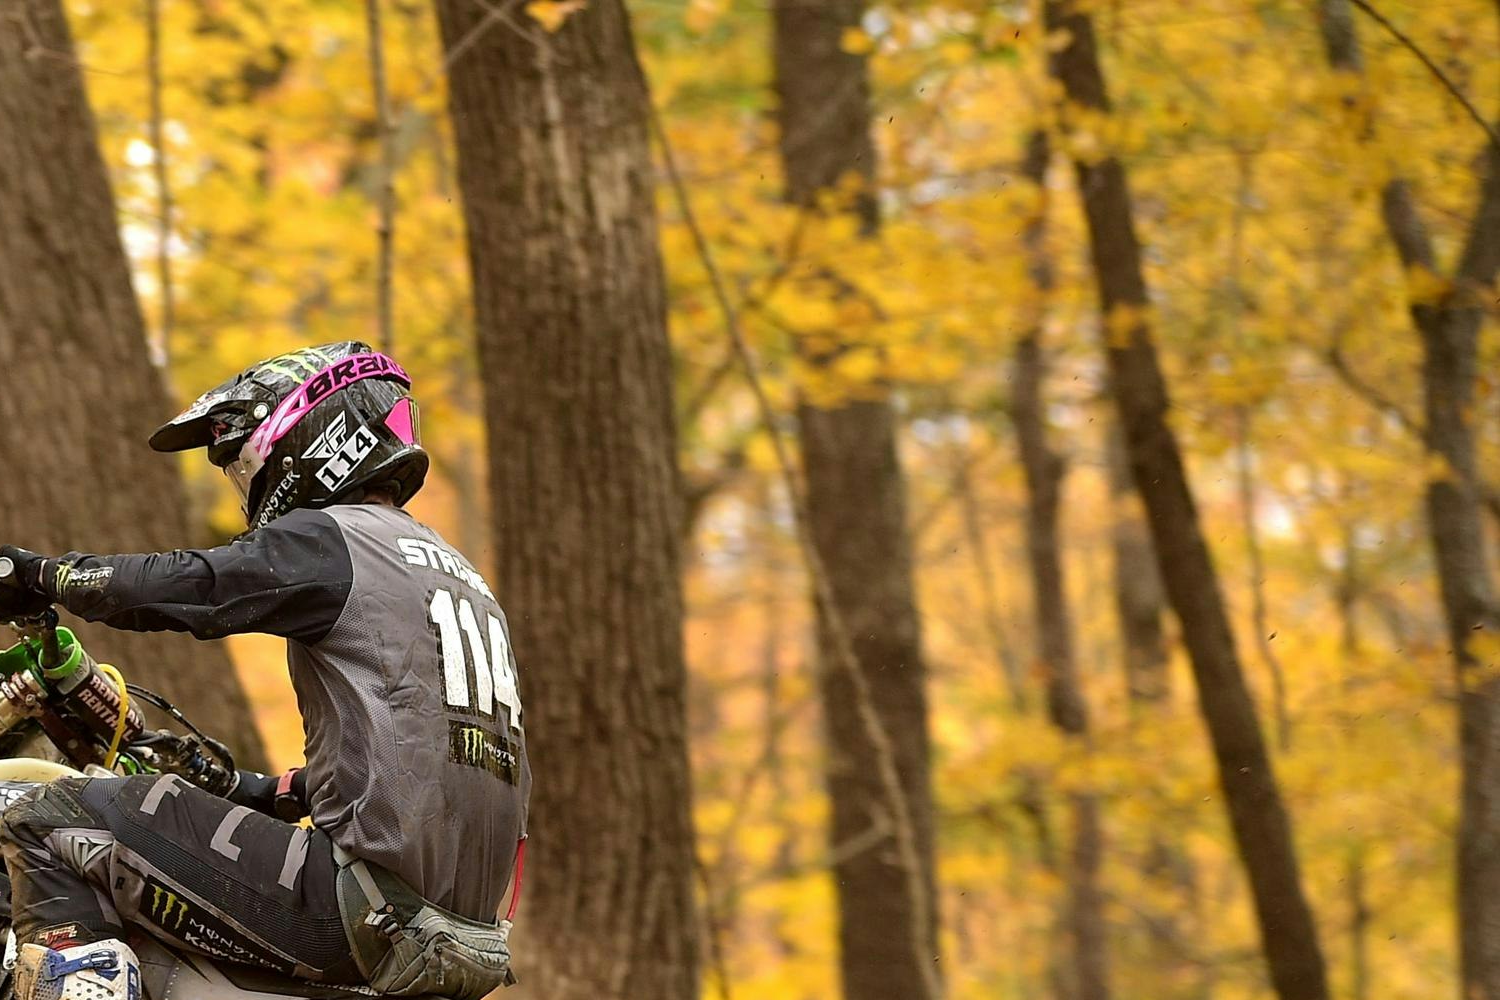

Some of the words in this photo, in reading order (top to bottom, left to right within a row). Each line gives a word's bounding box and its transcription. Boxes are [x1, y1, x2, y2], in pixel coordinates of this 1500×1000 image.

[320, 428, 375, 490] 114
[429, 588, 523, 730] 114
[78, 688, 134, 742] RENTHL
[89, 674, 143, 730] RENTAL
